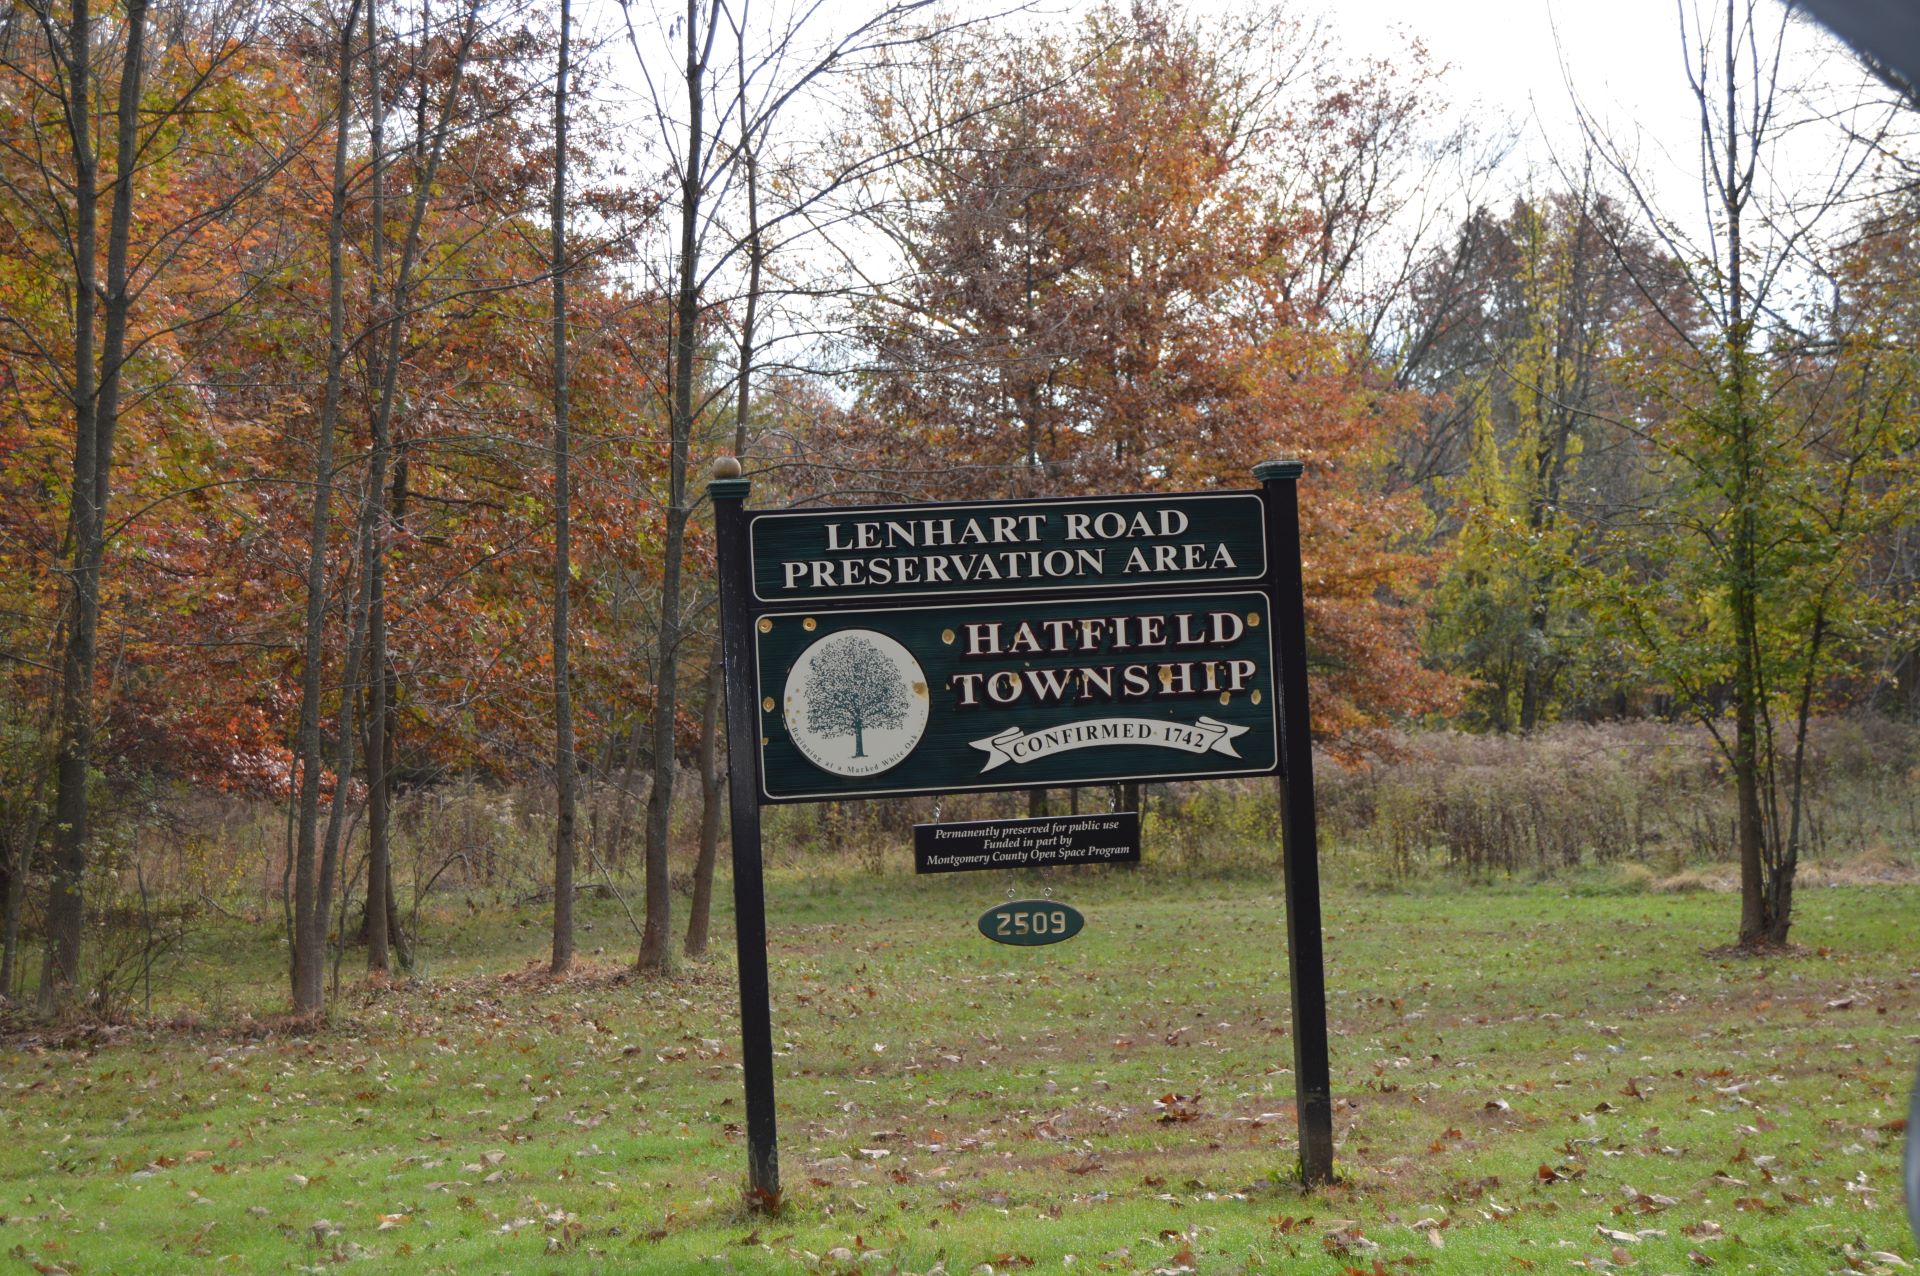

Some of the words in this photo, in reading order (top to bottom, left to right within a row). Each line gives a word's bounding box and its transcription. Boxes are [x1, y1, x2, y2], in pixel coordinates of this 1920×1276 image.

[824, 514, 1047, 552] LENHART
[1064, 509, 1189, 541] ROAD
[782, 547, 1106, 589] PRESERVATION
[1122, 543, 1237, 575] AREA
[964, 611, 1244, 656] HATFIELD
[953, 660, 1257, 706] TOWNSHIP
[792, 727, 822, 762] Beginning
[825, 761, 834, 769] at
[847, 763, 879, 774] Marked
[881, 750, 905, 766] White
[904, 735, 917, 749] Oak
[1013, 723, 1151, 757] CONFIRMED
[1165, 727, 1205, 748] 1742
[935, 825, 1000, 839] Permanently
[1002, 823, 1050, 837] preserved
[1051, 822, 1066, 835] for
[1068, 820, 1100, 834] public
[1102, 820, 1119, 830] use
[983, 837, 1020, 850] Funded
[1022, 837, 1033, 847] in
[1035, 837, 1057, 849] part
[1059, 836, 1073, 847] by
[927, 854, 990, 867] Montgomery
[992, 852, 1028, 864] County
[1030, 850, 1056, 862] Open
[1058, 848, 1086, 860] Space
[1088, 846, 1130, 858] Program
[997, 911, 1066, 935] 2509
